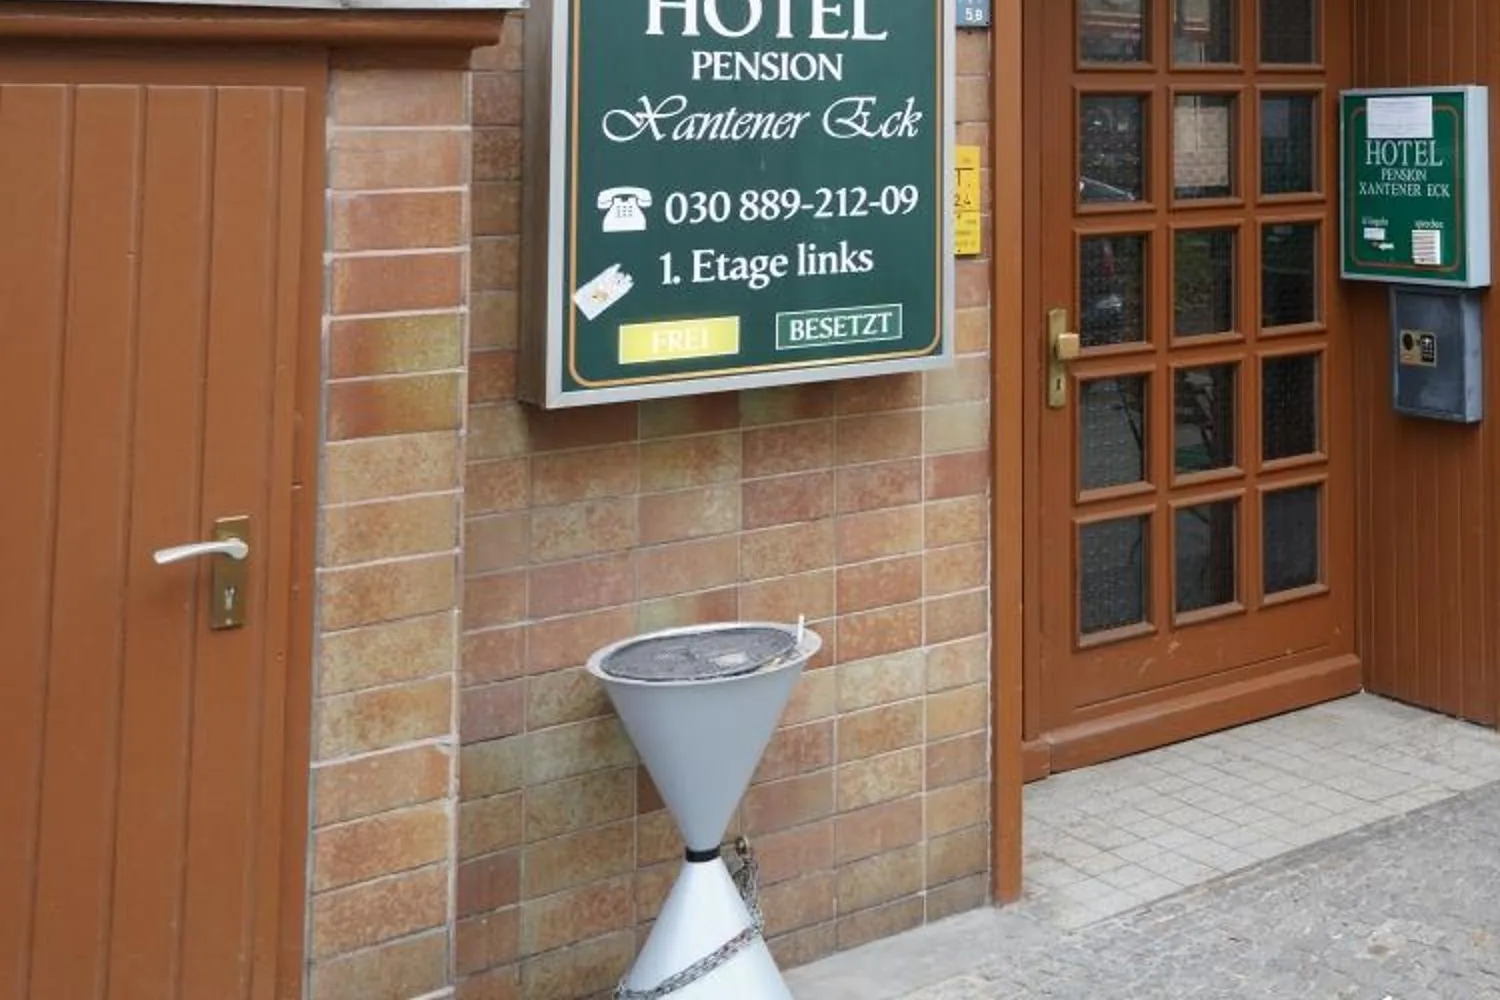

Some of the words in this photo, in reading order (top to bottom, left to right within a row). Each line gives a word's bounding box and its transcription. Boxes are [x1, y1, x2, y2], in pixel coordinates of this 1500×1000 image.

[691, 51, 843, 82] PENSION
[602, 95, 809, 142] Xantener
[823, 96, 922, 139] Eck
[1364, 140, 1443, 167] HOTEL
[1381, 168, 1427, 181] PENSION
[1359, 182, 1421, 197] XANTENER
[1427, 184, 1450, 197] ECK
[665, 192, 731, 225] 030
[739, 184, 919, 222] 889-212-09
[659, 253, 680, 285] 1.
[691, 249, 789, 289] Etage
[798, 240, 874, 277] links
[652, 328, 709, 352] FREI
[789, 312, 893, 341] BESETZT
